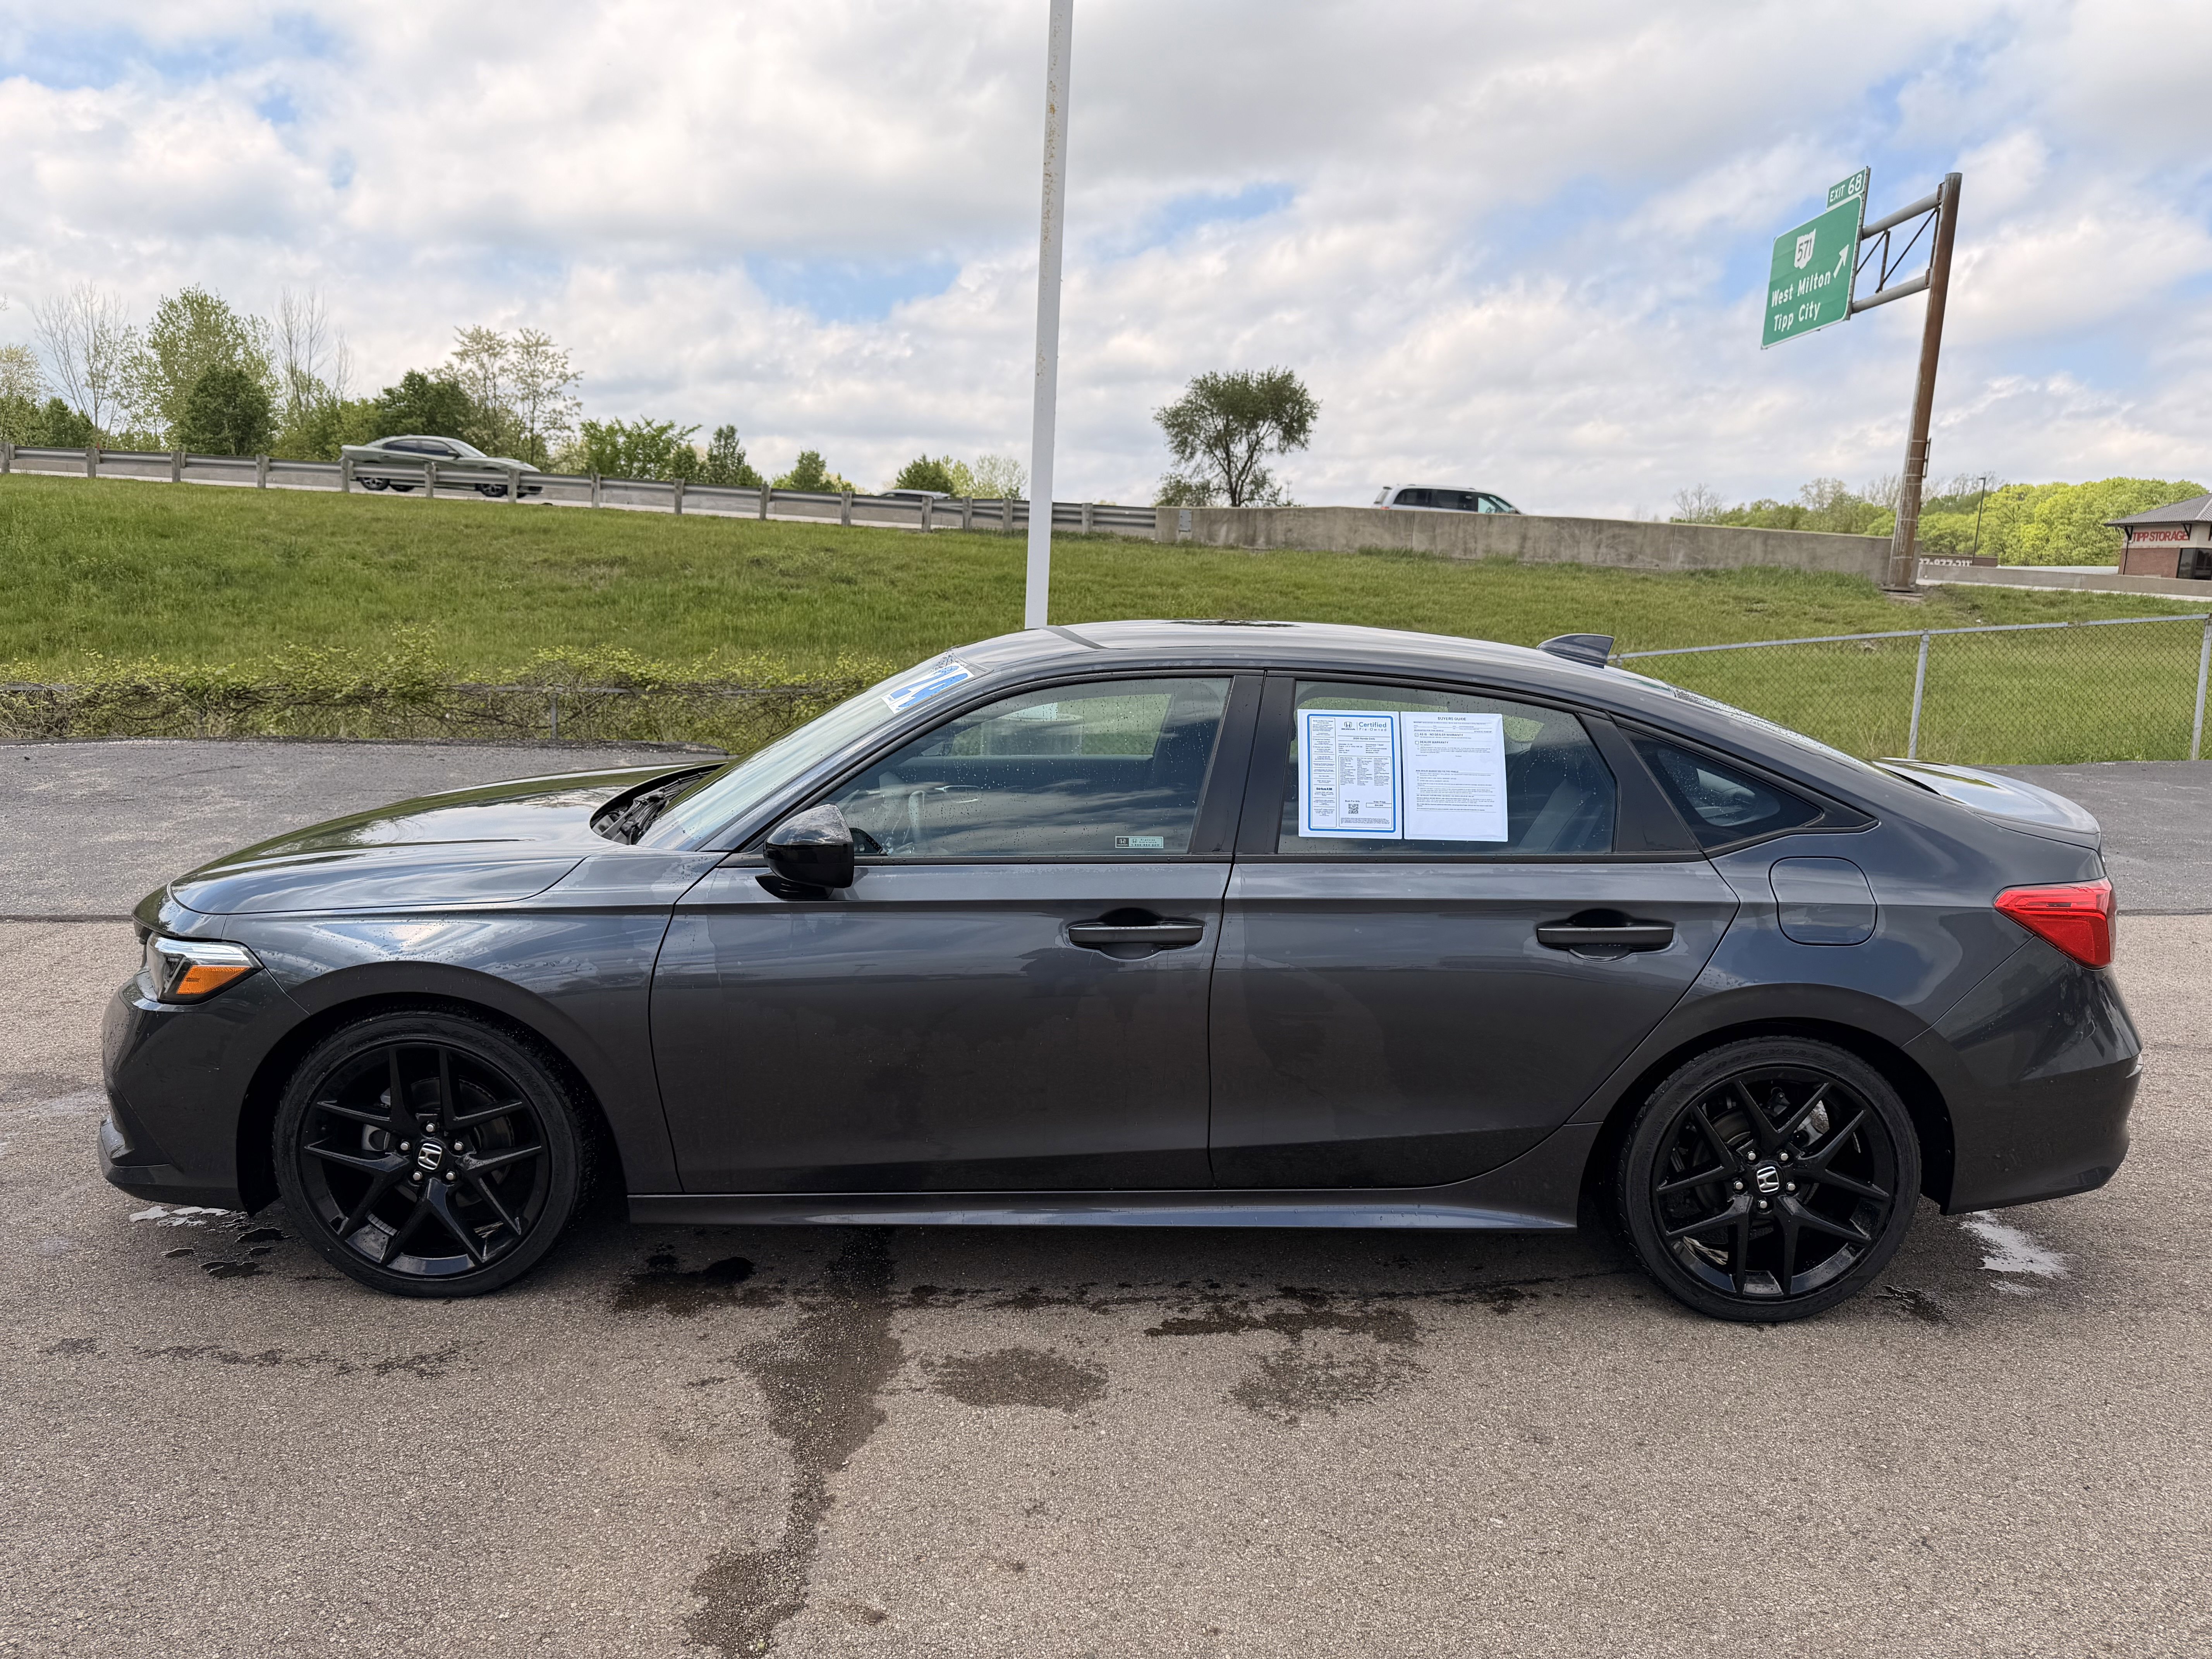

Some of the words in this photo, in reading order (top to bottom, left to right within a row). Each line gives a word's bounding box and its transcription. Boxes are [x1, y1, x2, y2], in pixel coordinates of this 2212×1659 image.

[1829, 185, 1845, 203] EXIT
[1848, 173, 1862, 195] 68
[1797, 237, 1812, 262] 571
[1771, 285, 1793, 307] West
[1797, 271, 1831, 297] Milton
[1774, 313, 1793, 332] Tipp
[1798, 302, 1821, 321] City
[2133, 532, 2149, 542] TIPP
[2149, 531, 2189, 541] STORAGE
